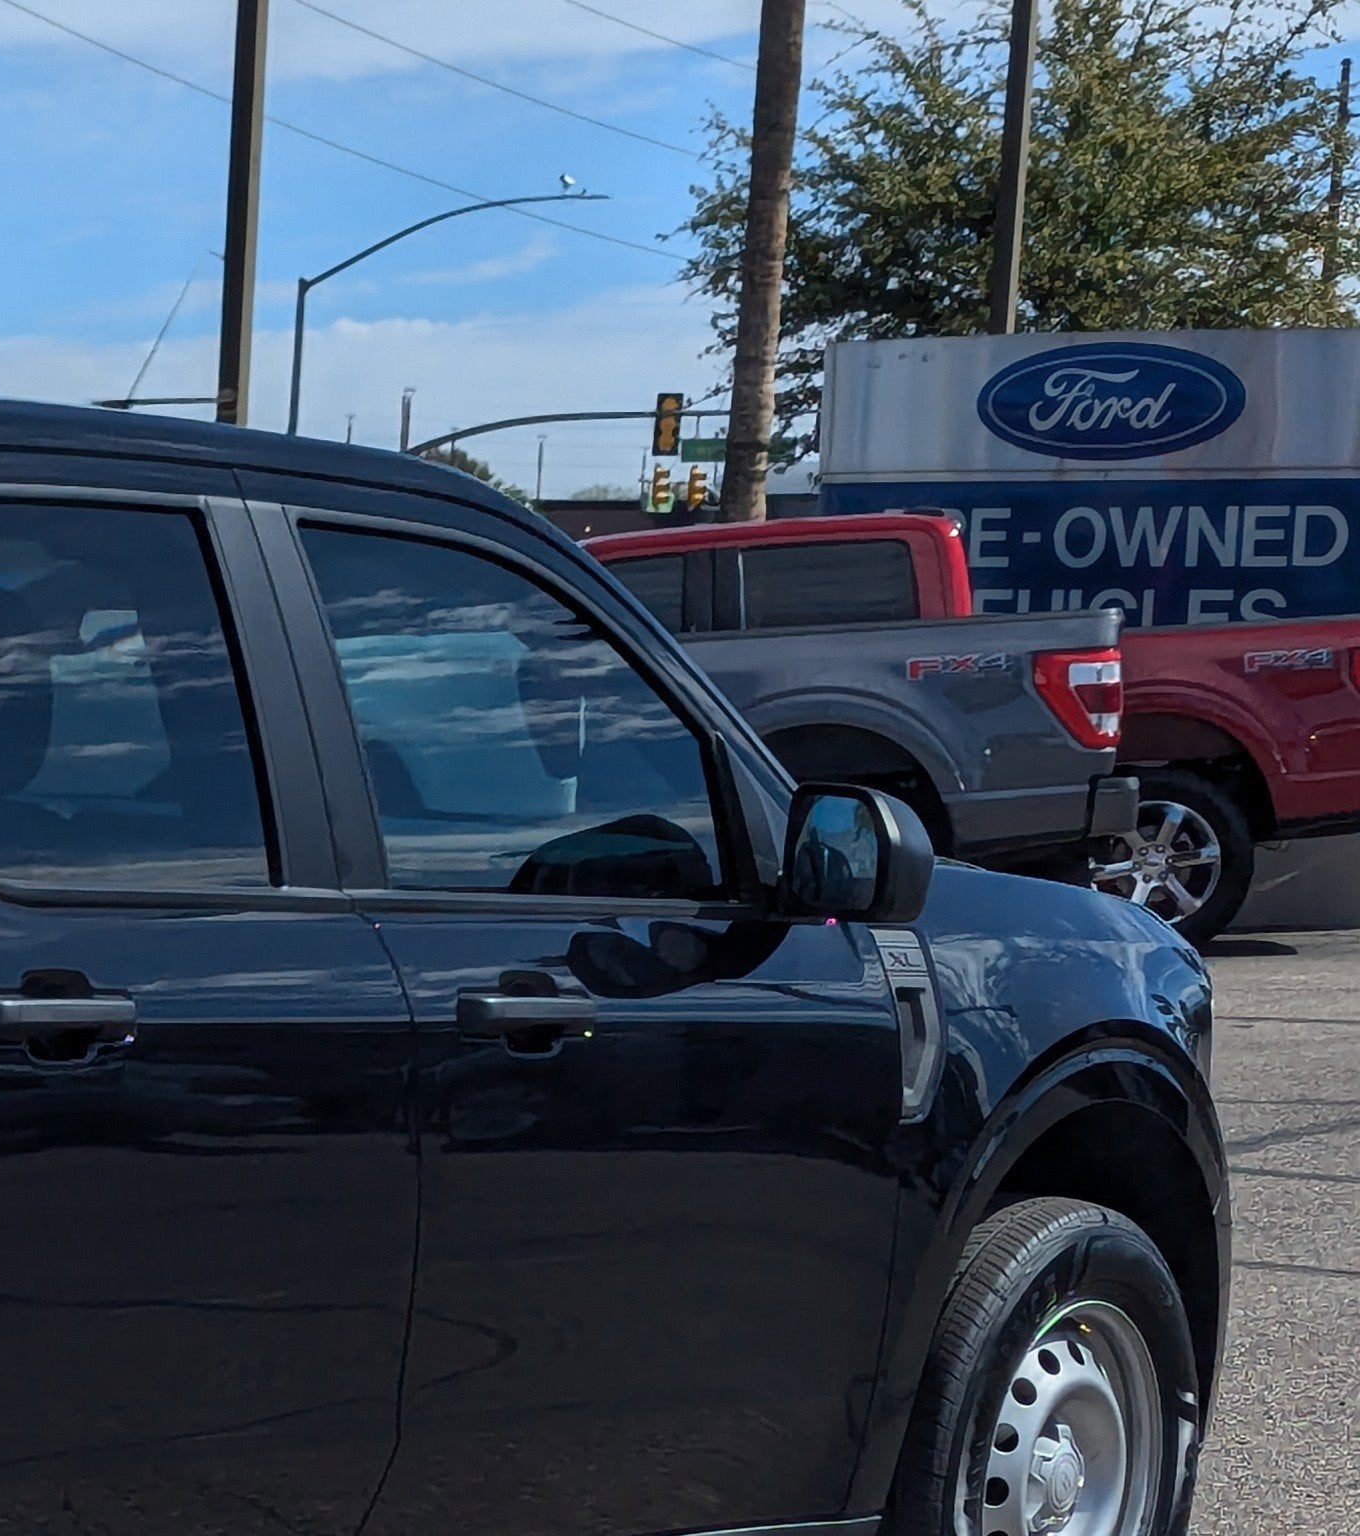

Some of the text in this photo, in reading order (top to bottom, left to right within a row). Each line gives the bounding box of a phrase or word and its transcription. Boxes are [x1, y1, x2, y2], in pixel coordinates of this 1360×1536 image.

[1029, 367, 1177, 431] Ford
[883, 506, 1349, 568] E-OWNED
[906, 653, 1011, 682] FX4
[1244, 647, 1334, 674] FX4
[888, 951, 921, 967] XL
